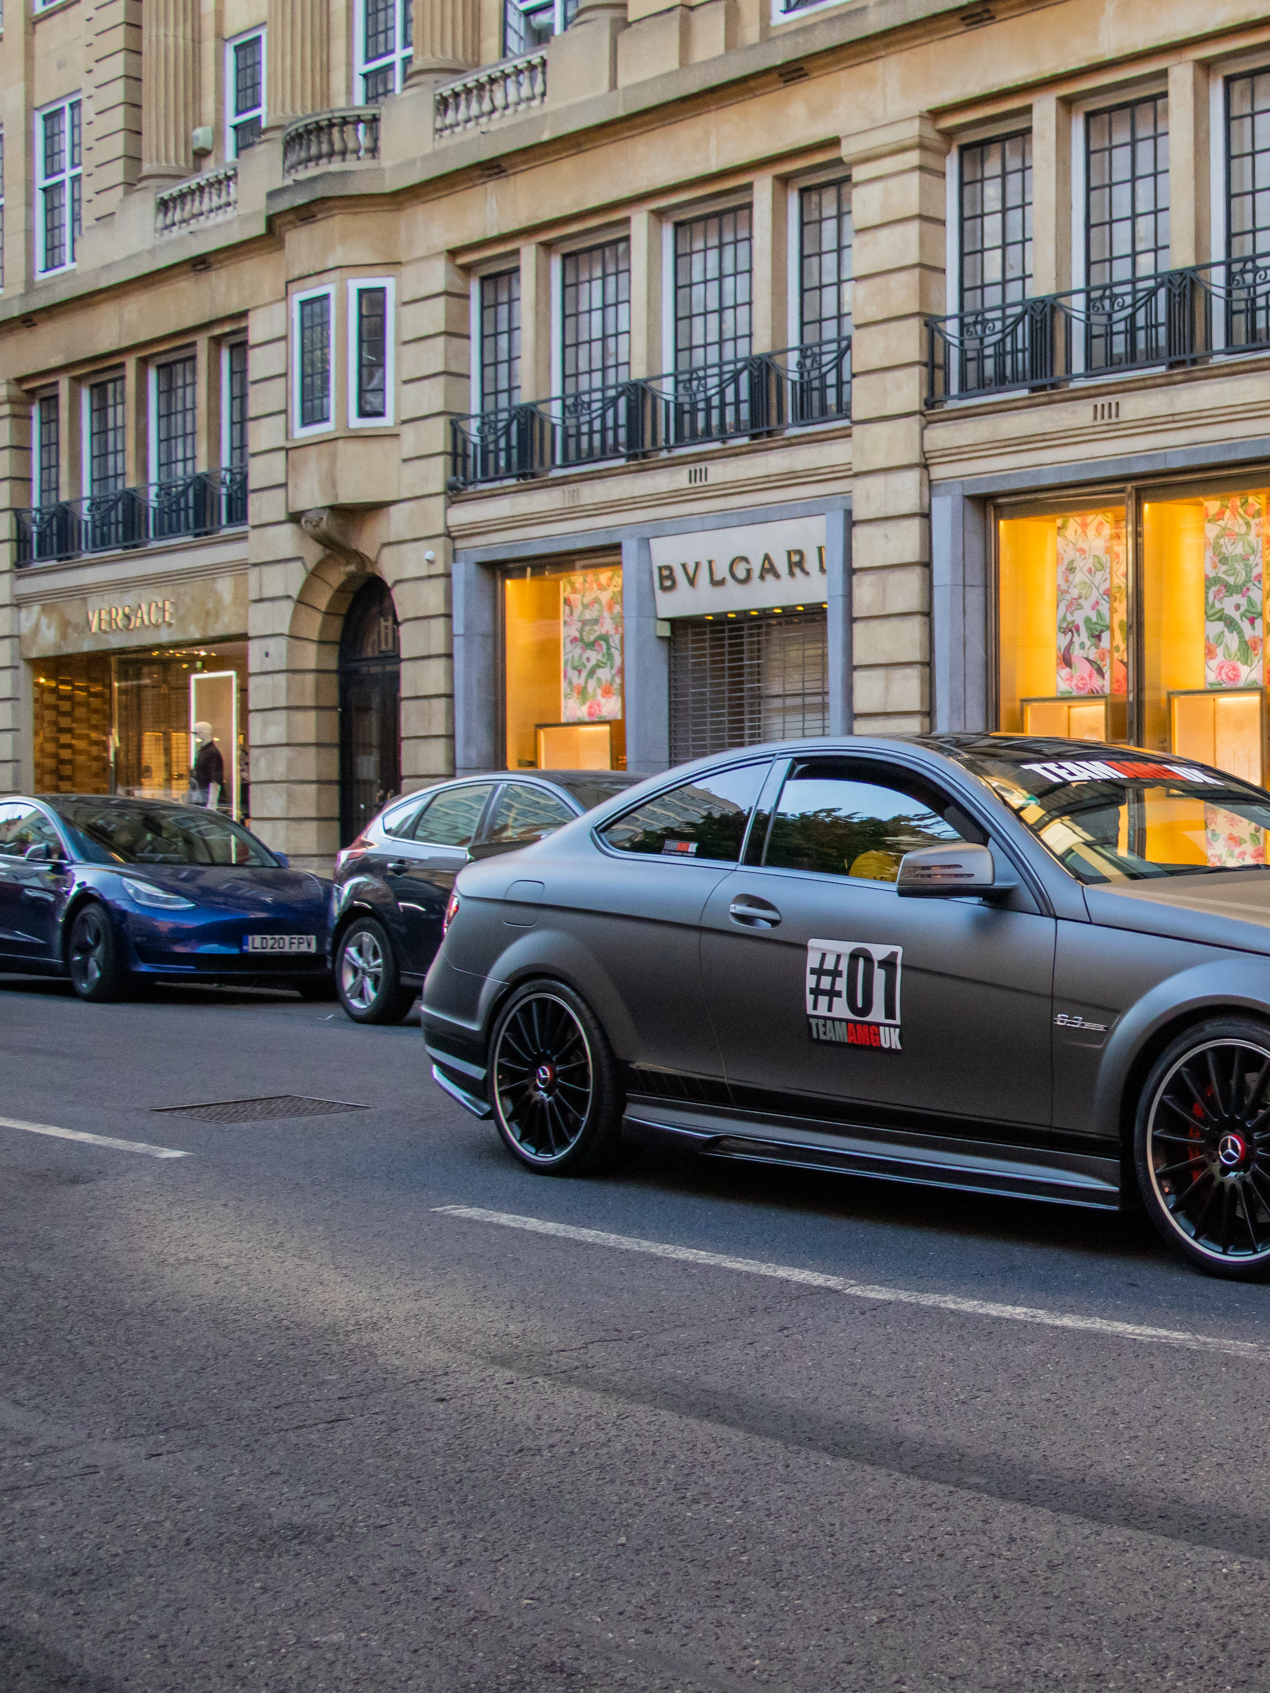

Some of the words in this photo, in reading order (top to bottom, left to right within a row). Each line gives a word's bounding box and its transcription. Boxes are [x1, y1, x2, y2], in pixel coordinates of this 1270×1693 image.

[656, 545, 827, 593] BVLGARI
[88, 599, 175, 633] VERSACE
[251, 937, 285, 950] LD20
[289, 937, 313, 950] FPV
[808, 946, 899, 1021] #01
